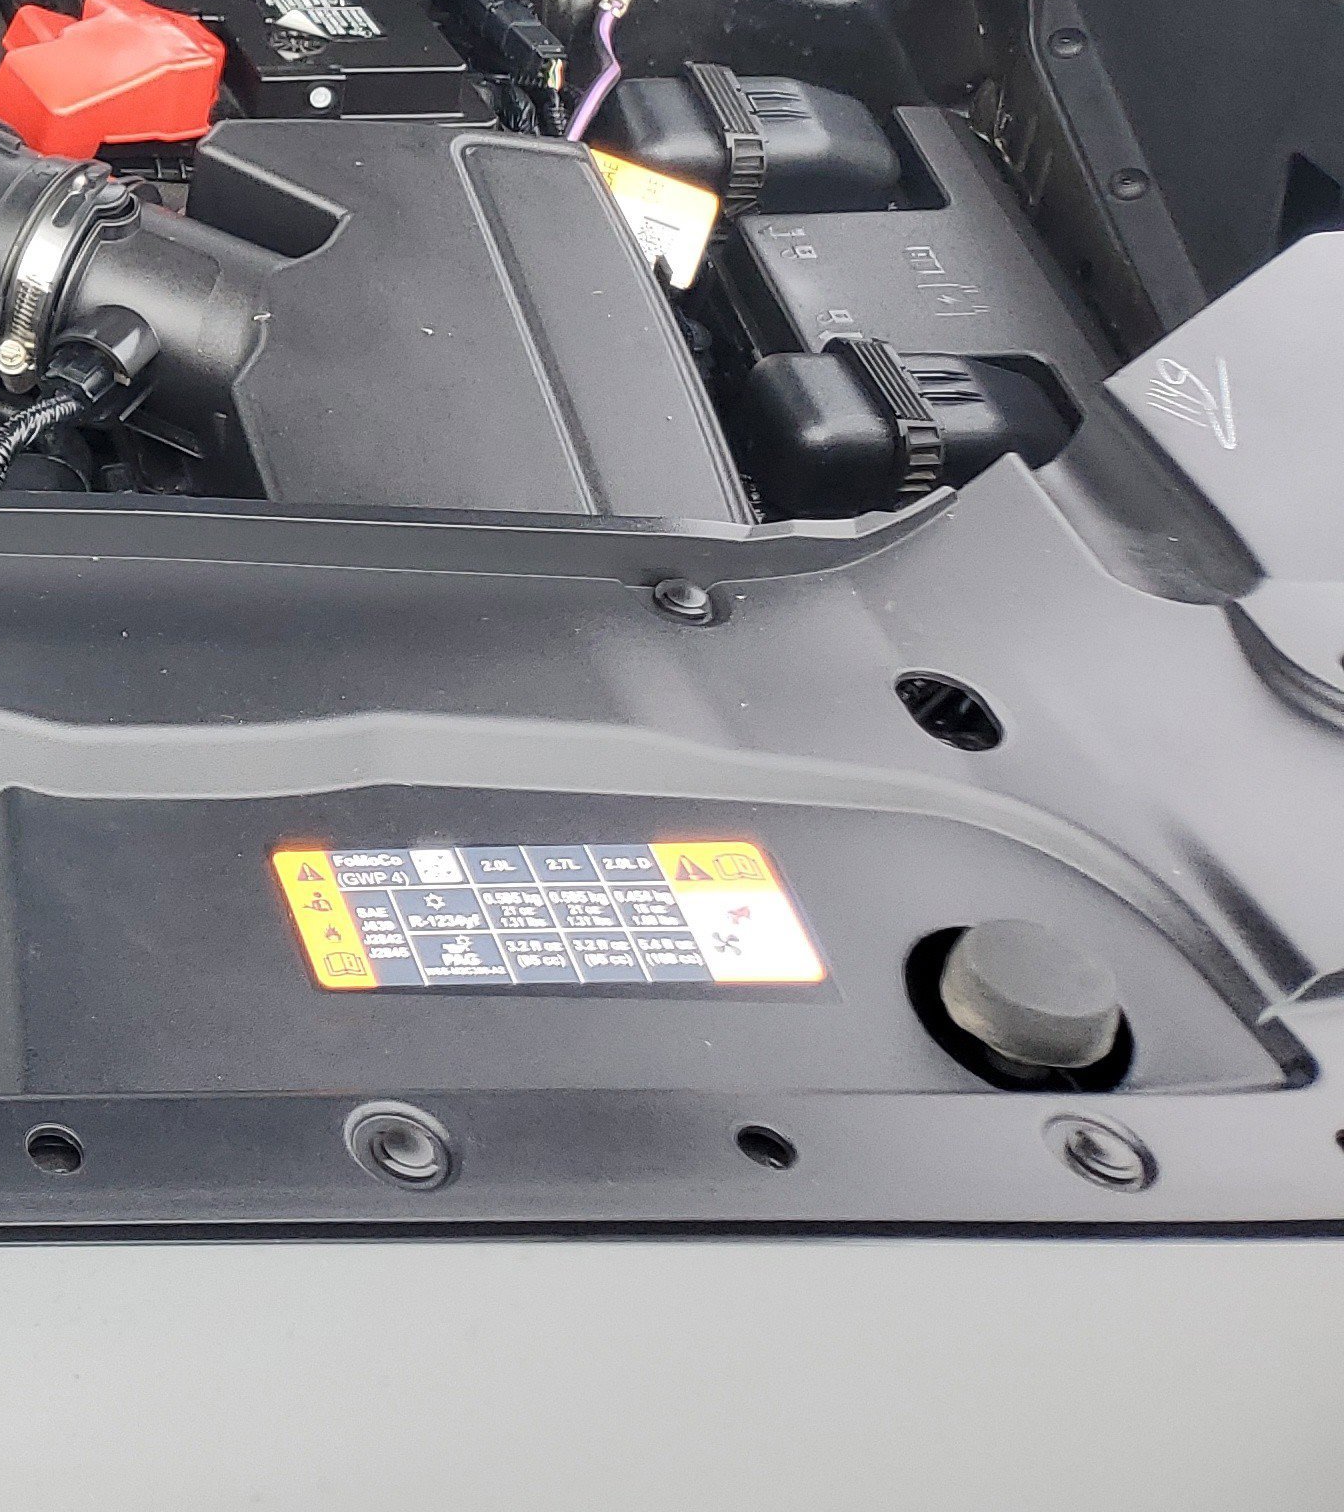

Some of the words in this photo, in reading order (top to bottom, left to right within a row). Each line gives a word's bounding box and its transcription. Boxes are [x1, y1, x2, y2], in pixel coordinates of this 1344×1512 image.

[332, 853, 405, 868] FoMoCo
[480, 859, 517, 872] 2.0L
[545, 858, 581, 871] 2.7L
[336, 871, 387, 887] (GWP
[391, 871, 410, 886] 4)
[355, 907, 389, 918] SAE
[408, 914, 480, 929] R-1234yf
